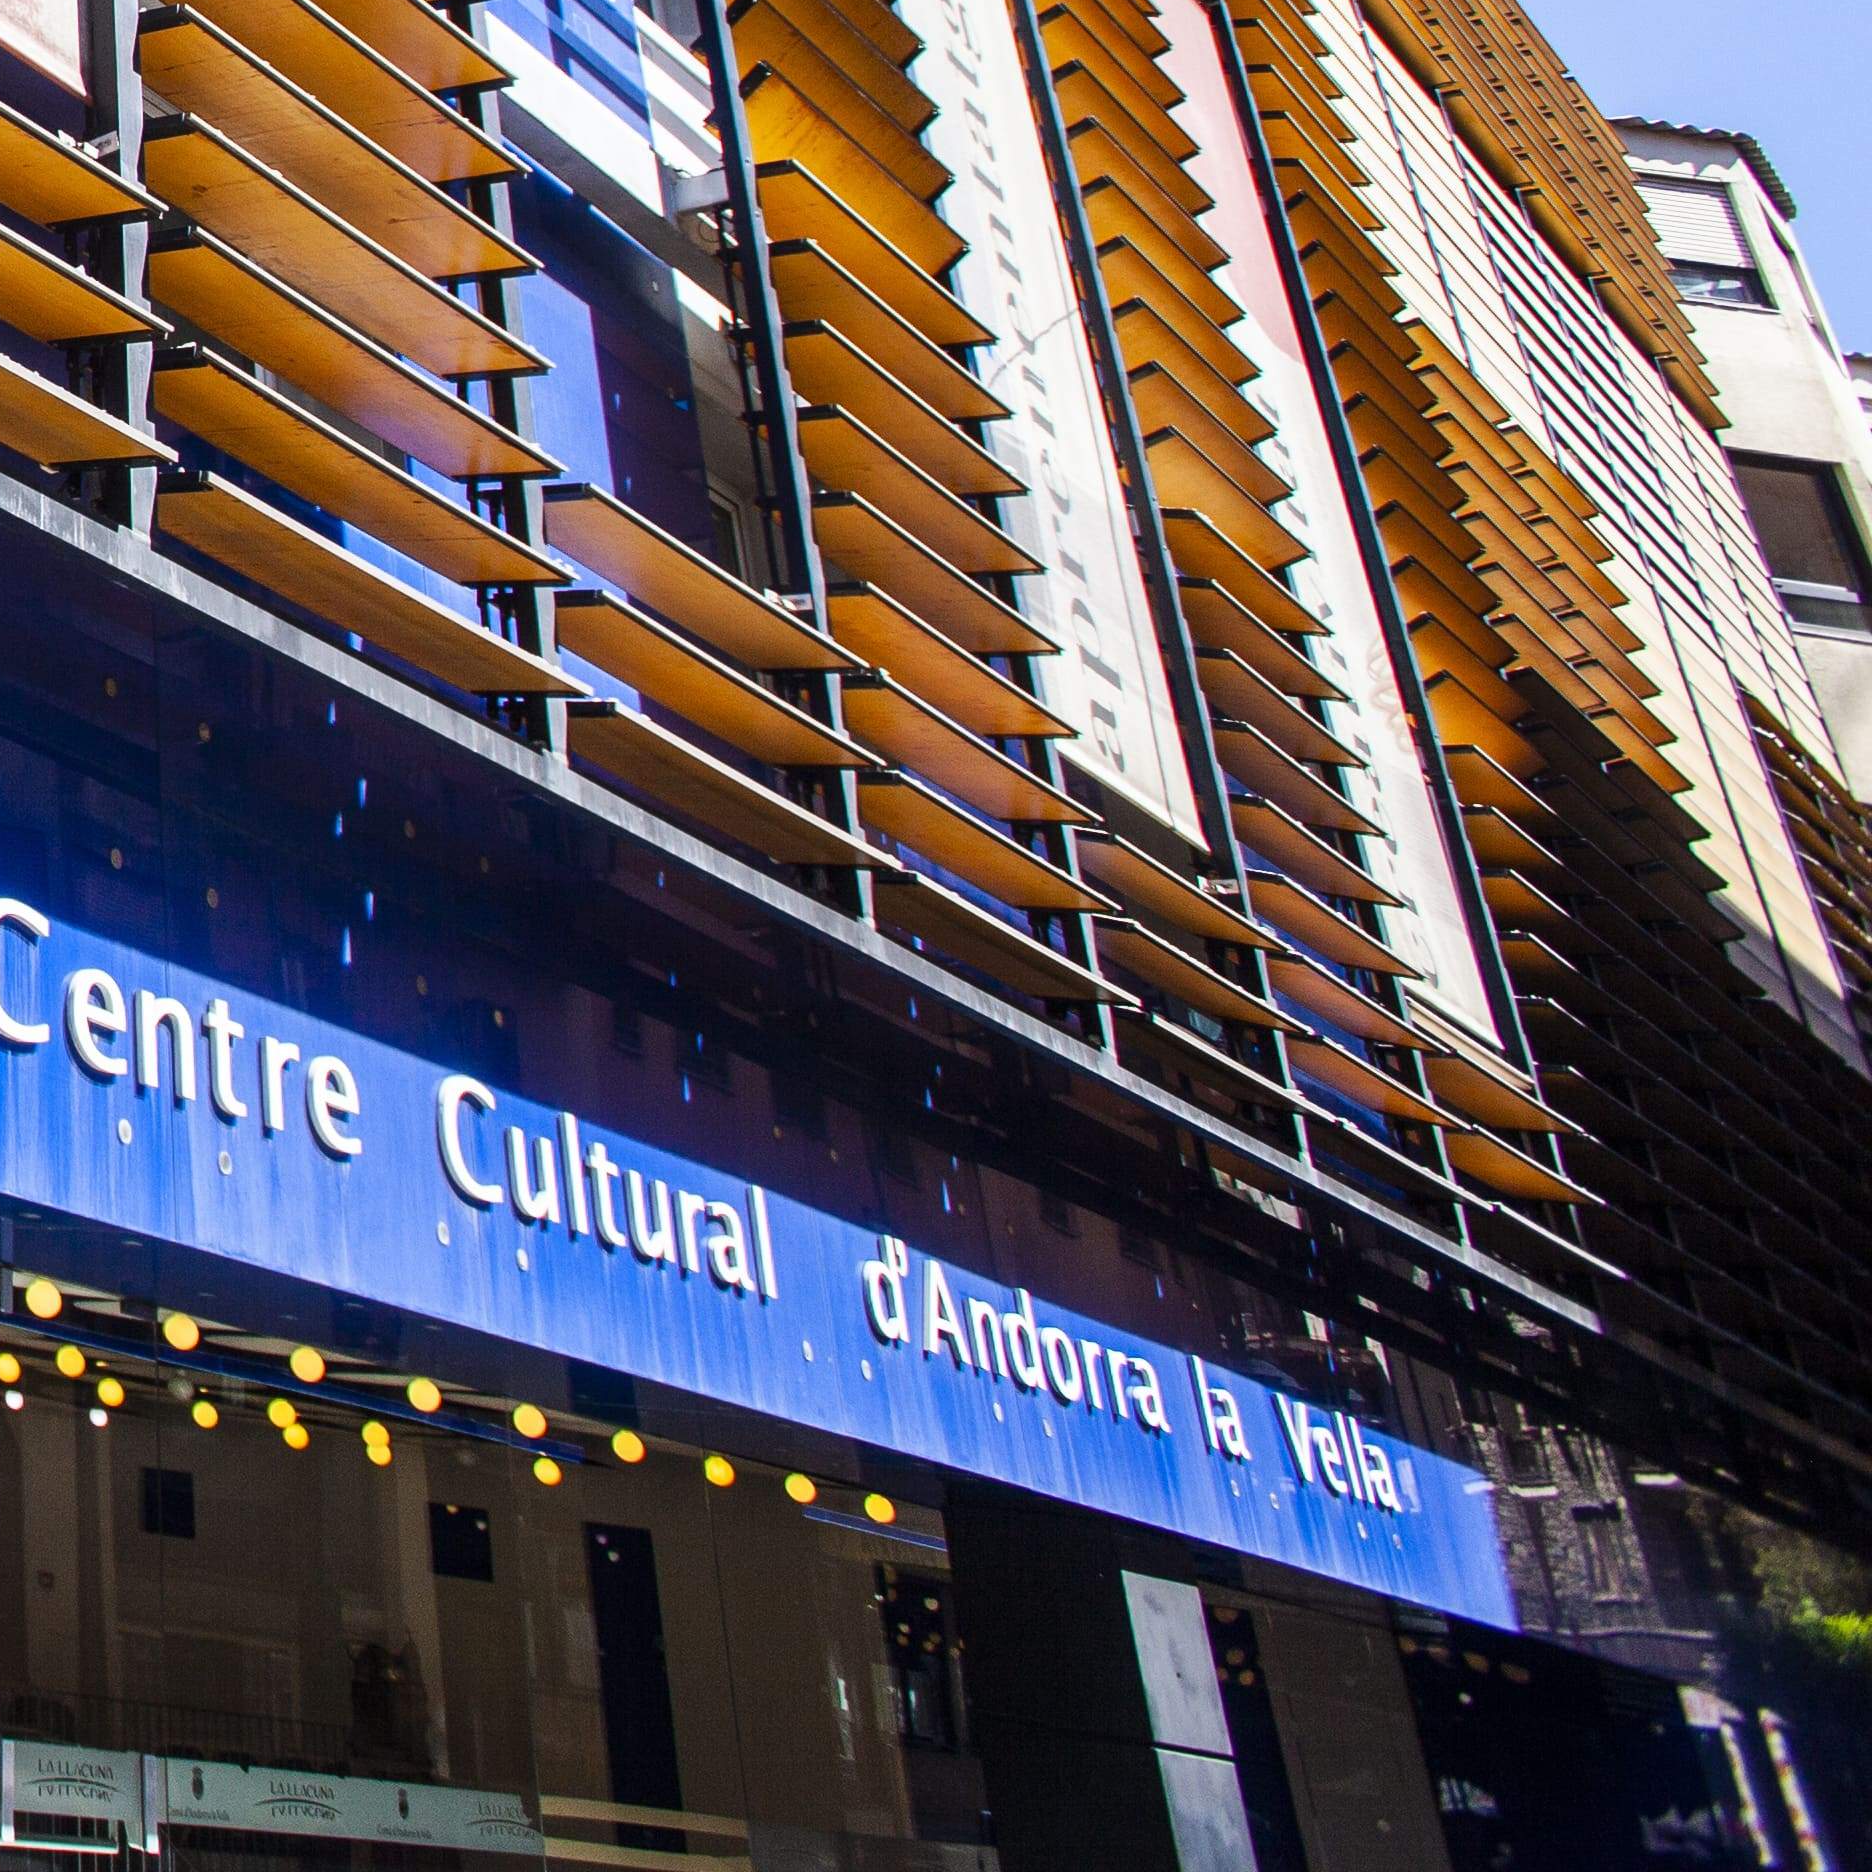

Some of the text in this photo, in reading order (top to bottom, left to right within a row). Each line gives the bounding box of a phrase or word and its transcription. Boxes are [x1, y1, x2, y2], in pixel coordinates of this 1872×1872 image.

[436, 1074, 778, 1300] Cultural
[862, 1234, 1171, 1434] d'Andorra
[1187, 1354, 1252, 1461] la
[1273, 1391, 1403, 1514] Vella
